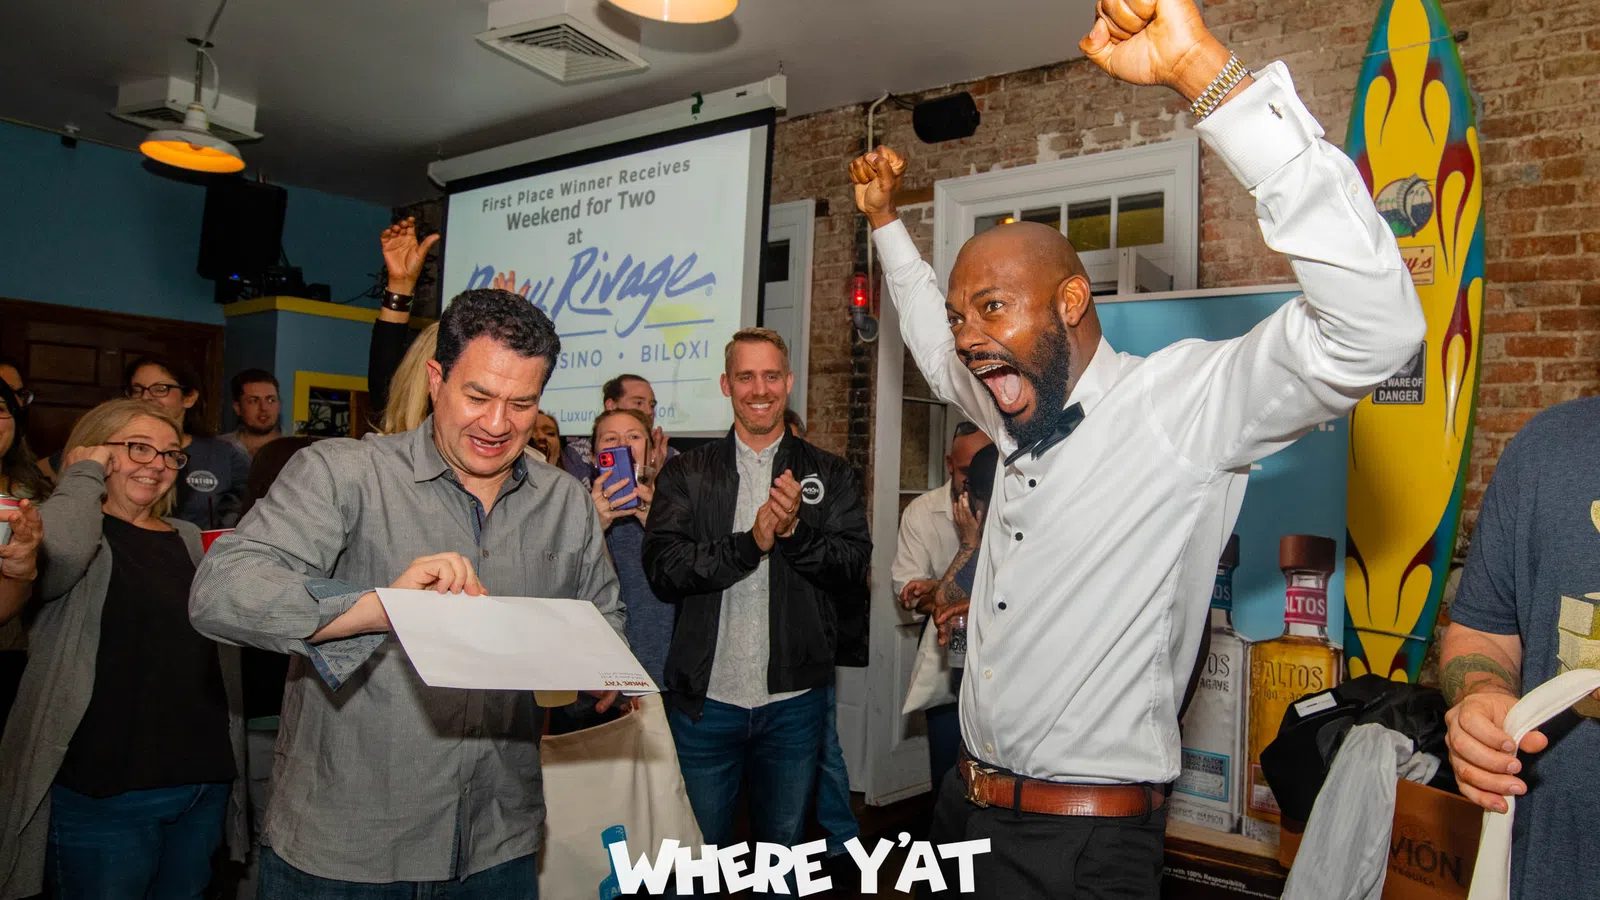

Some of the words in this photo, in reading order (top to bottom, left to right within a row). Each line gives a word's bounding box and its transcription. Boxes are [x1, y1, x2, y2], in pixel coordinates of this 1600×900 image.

[482, 194, 512, 213] First
[517, 187, 554, 207] Place
[560, 174, 613, 197] Winner
[619, 158, 691, 185] Receives
[507, 199, 581, 231] Weekend
[586, 195, 612, 217] for
[618, 189, 656, 211] Two
[567, 228, 583, 246] at
[554, 349, 603, 370] SINO
[641, 339, 709, 363] BILOXI
[1379, 390, 1419, 402] DANGER
[1411, 377, 1423, 388] OF
[1264, 660, 1323, 691] ALTOS
[1391, 835, 1467, 889] VIÓN
